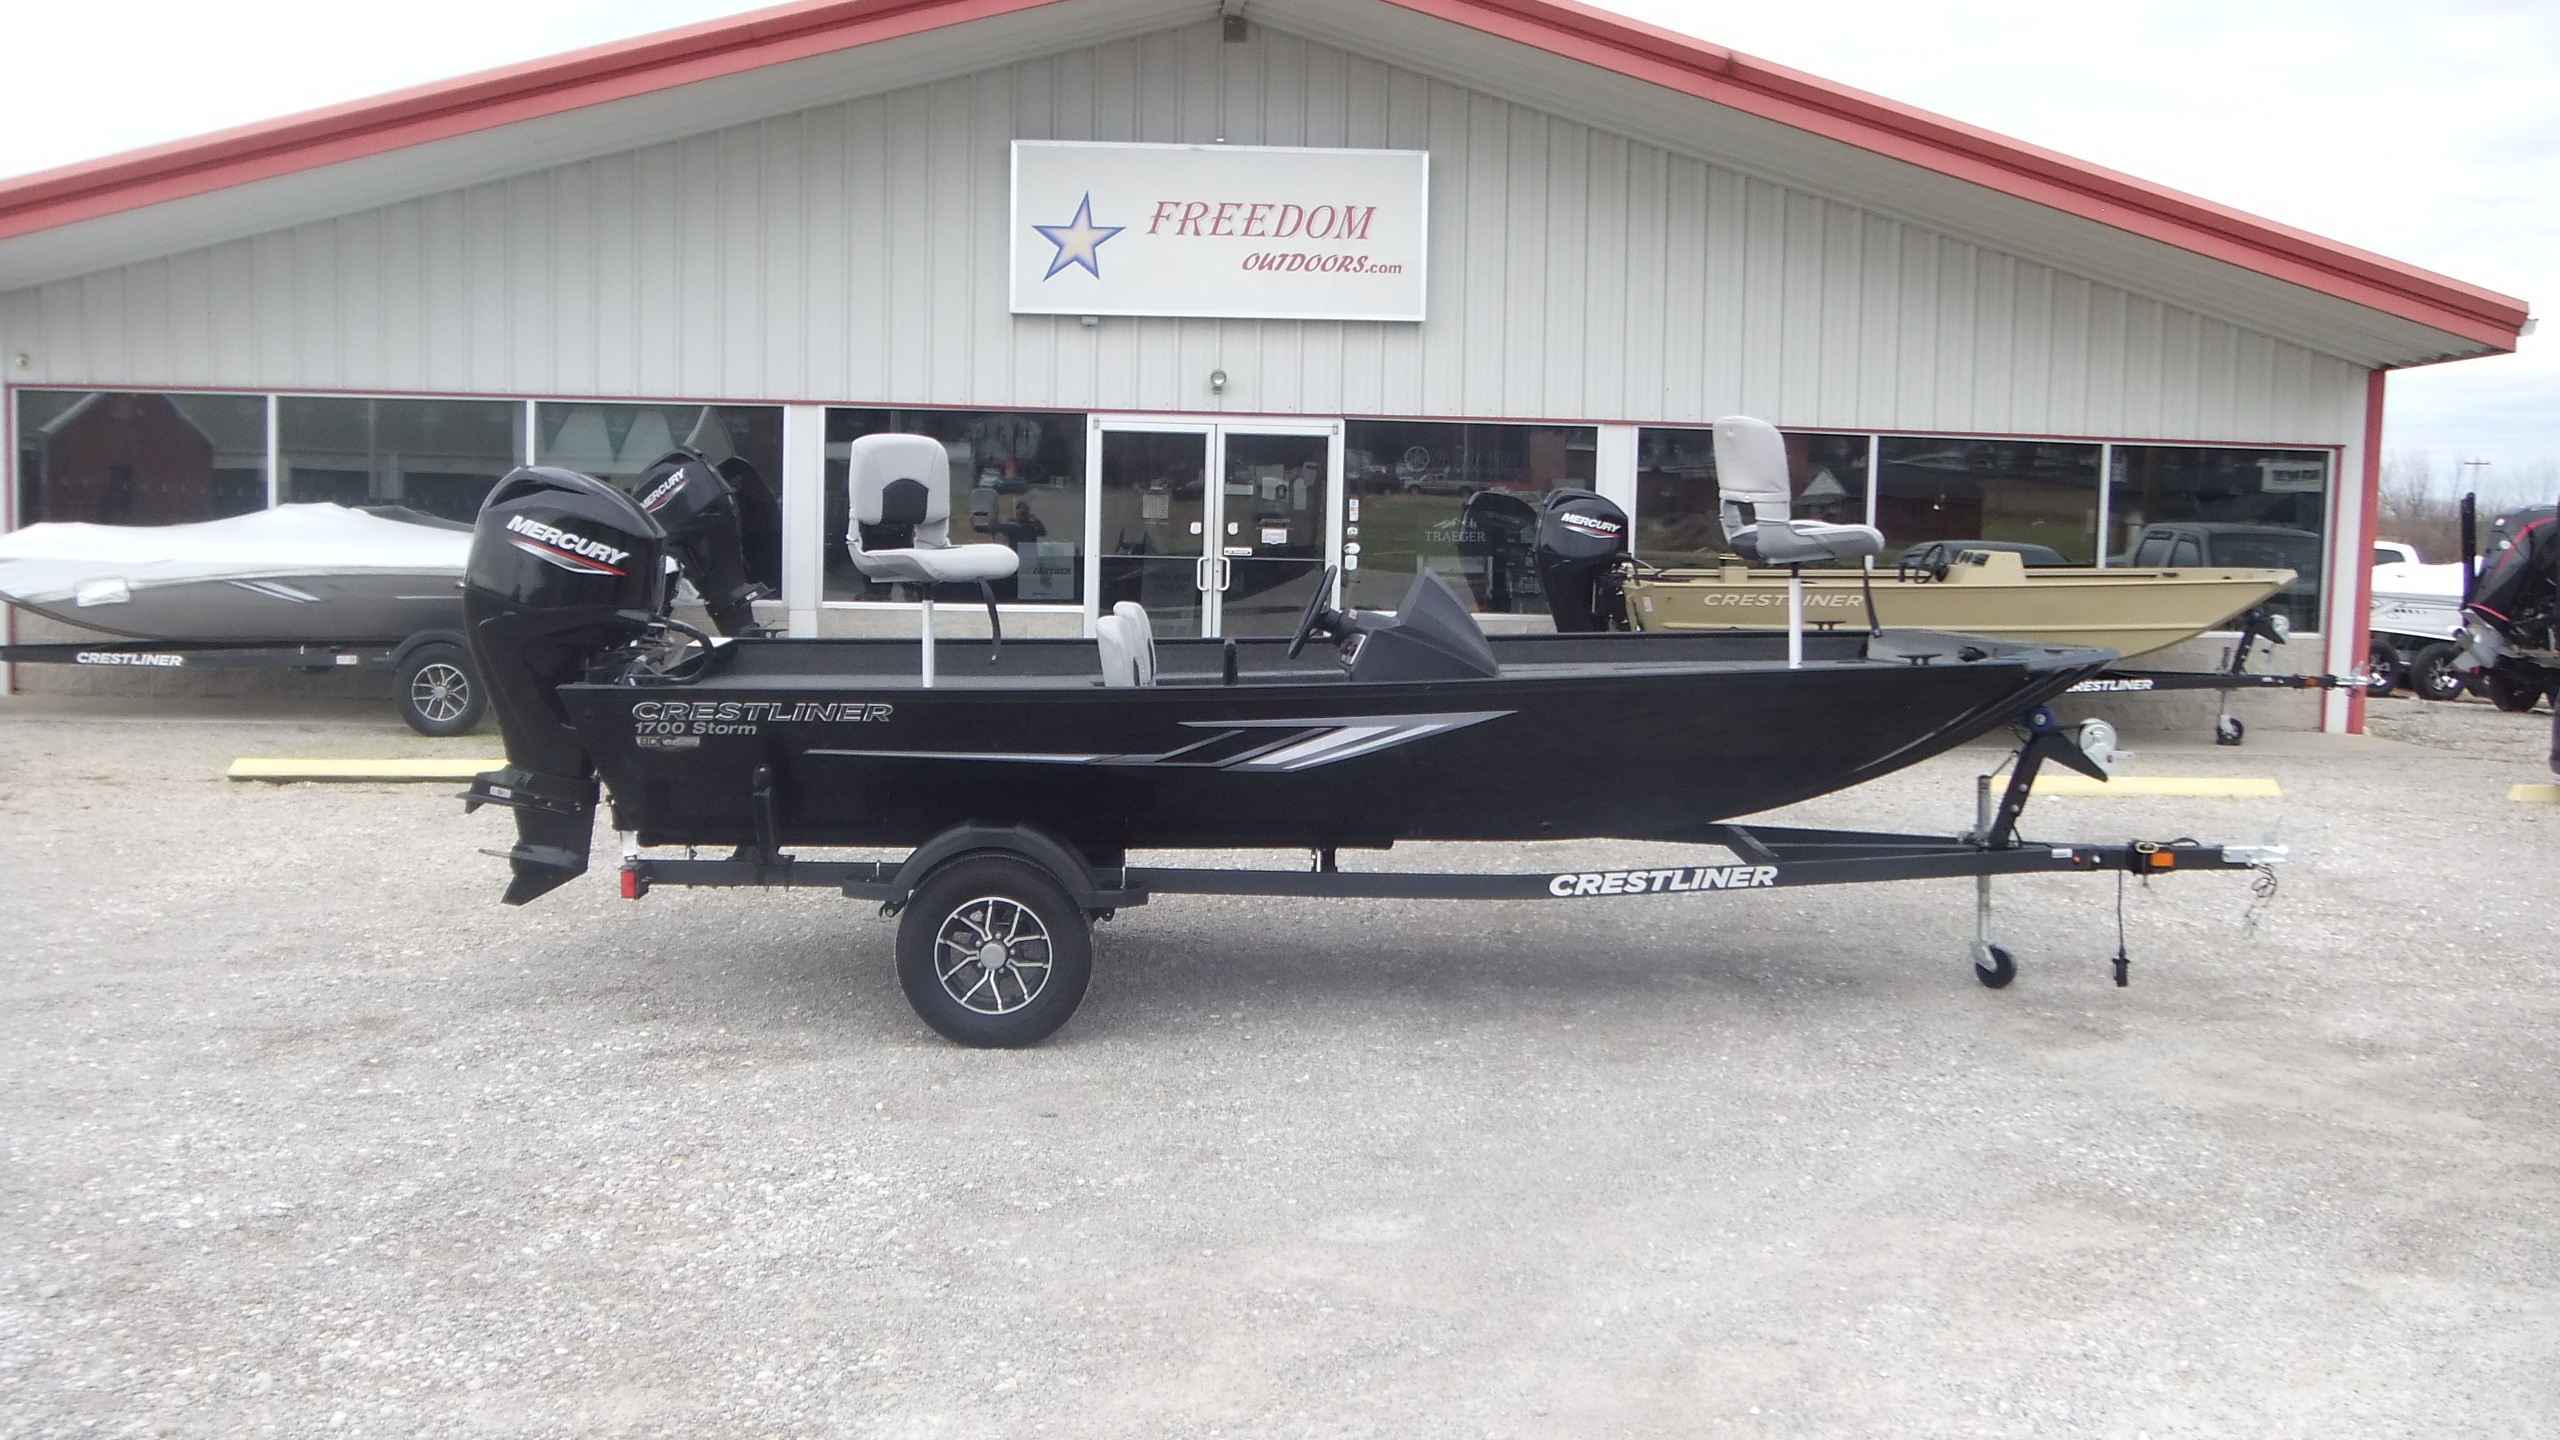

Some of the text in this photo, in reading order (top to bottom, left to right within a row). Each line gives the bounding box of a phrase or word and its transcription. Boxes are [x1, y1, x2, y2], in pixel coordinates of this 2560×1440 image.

[1146, 201, 1377, 240] FREEDOM
[1242, 253, 1402, 274] OUTDOORS.com
[1561, 513, 1621, 533] MERCURY
[506, 515, 631, 565] MERCURY
[1425, 531, 1486, 542] TRAEGER
[1703, 594, 1865, 607] CRESTINER
[76, 652, 183, 667] CRESTLINER
[2065, 679, 2153, 693] RESTLINER
[632, 701, 894, 722] CRESTLINER
[635, 721, 757, 735] 1700 Storm
[1549, 866, 1778, 896] CRESTLINER
